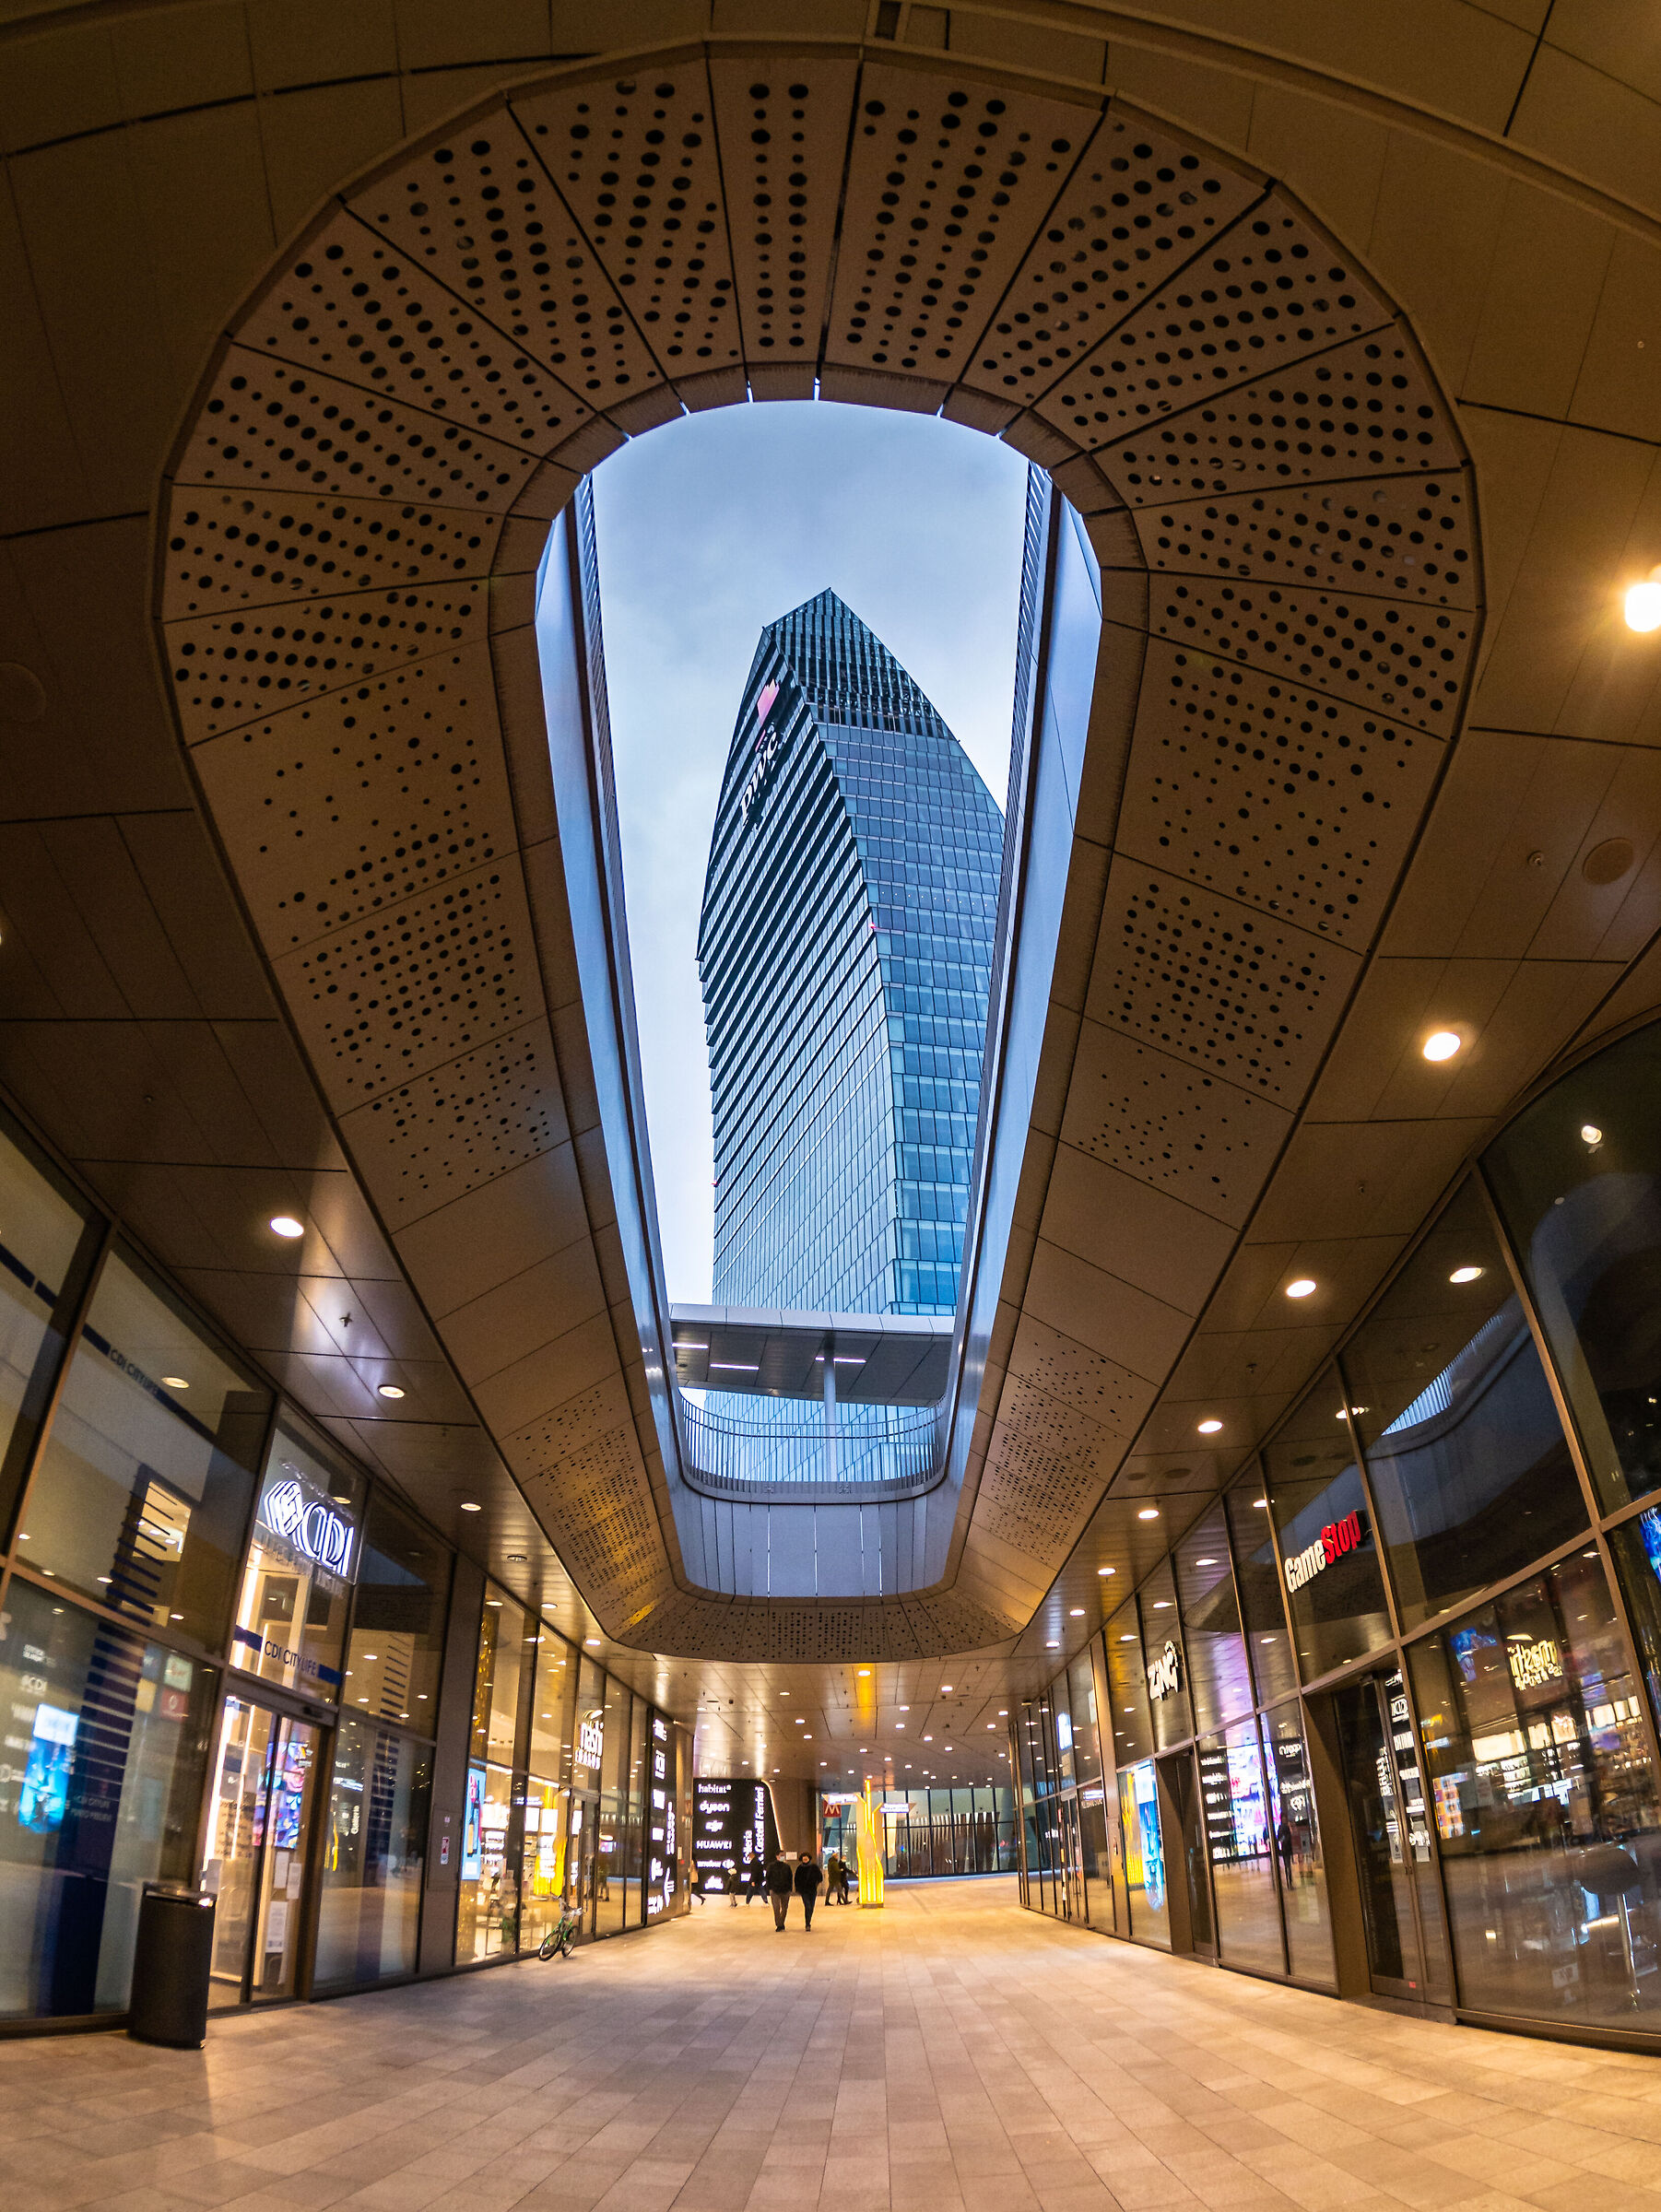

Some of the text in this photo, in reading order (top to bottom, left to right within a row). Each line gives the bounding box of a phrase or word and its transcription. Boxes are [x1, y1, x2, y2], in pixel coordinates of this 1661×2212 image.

[299, 1501, 355, 1578] CDI
[1284, 1509, 1362, 1594] GameStop
[265, 1641, 318, 1676] CDI CITYLIFE
[698, 1783, 727, 1794] habitat
[700, 1800, 730, 1814] dyson
[697, 1840, 732, 1850] HUAWEI
